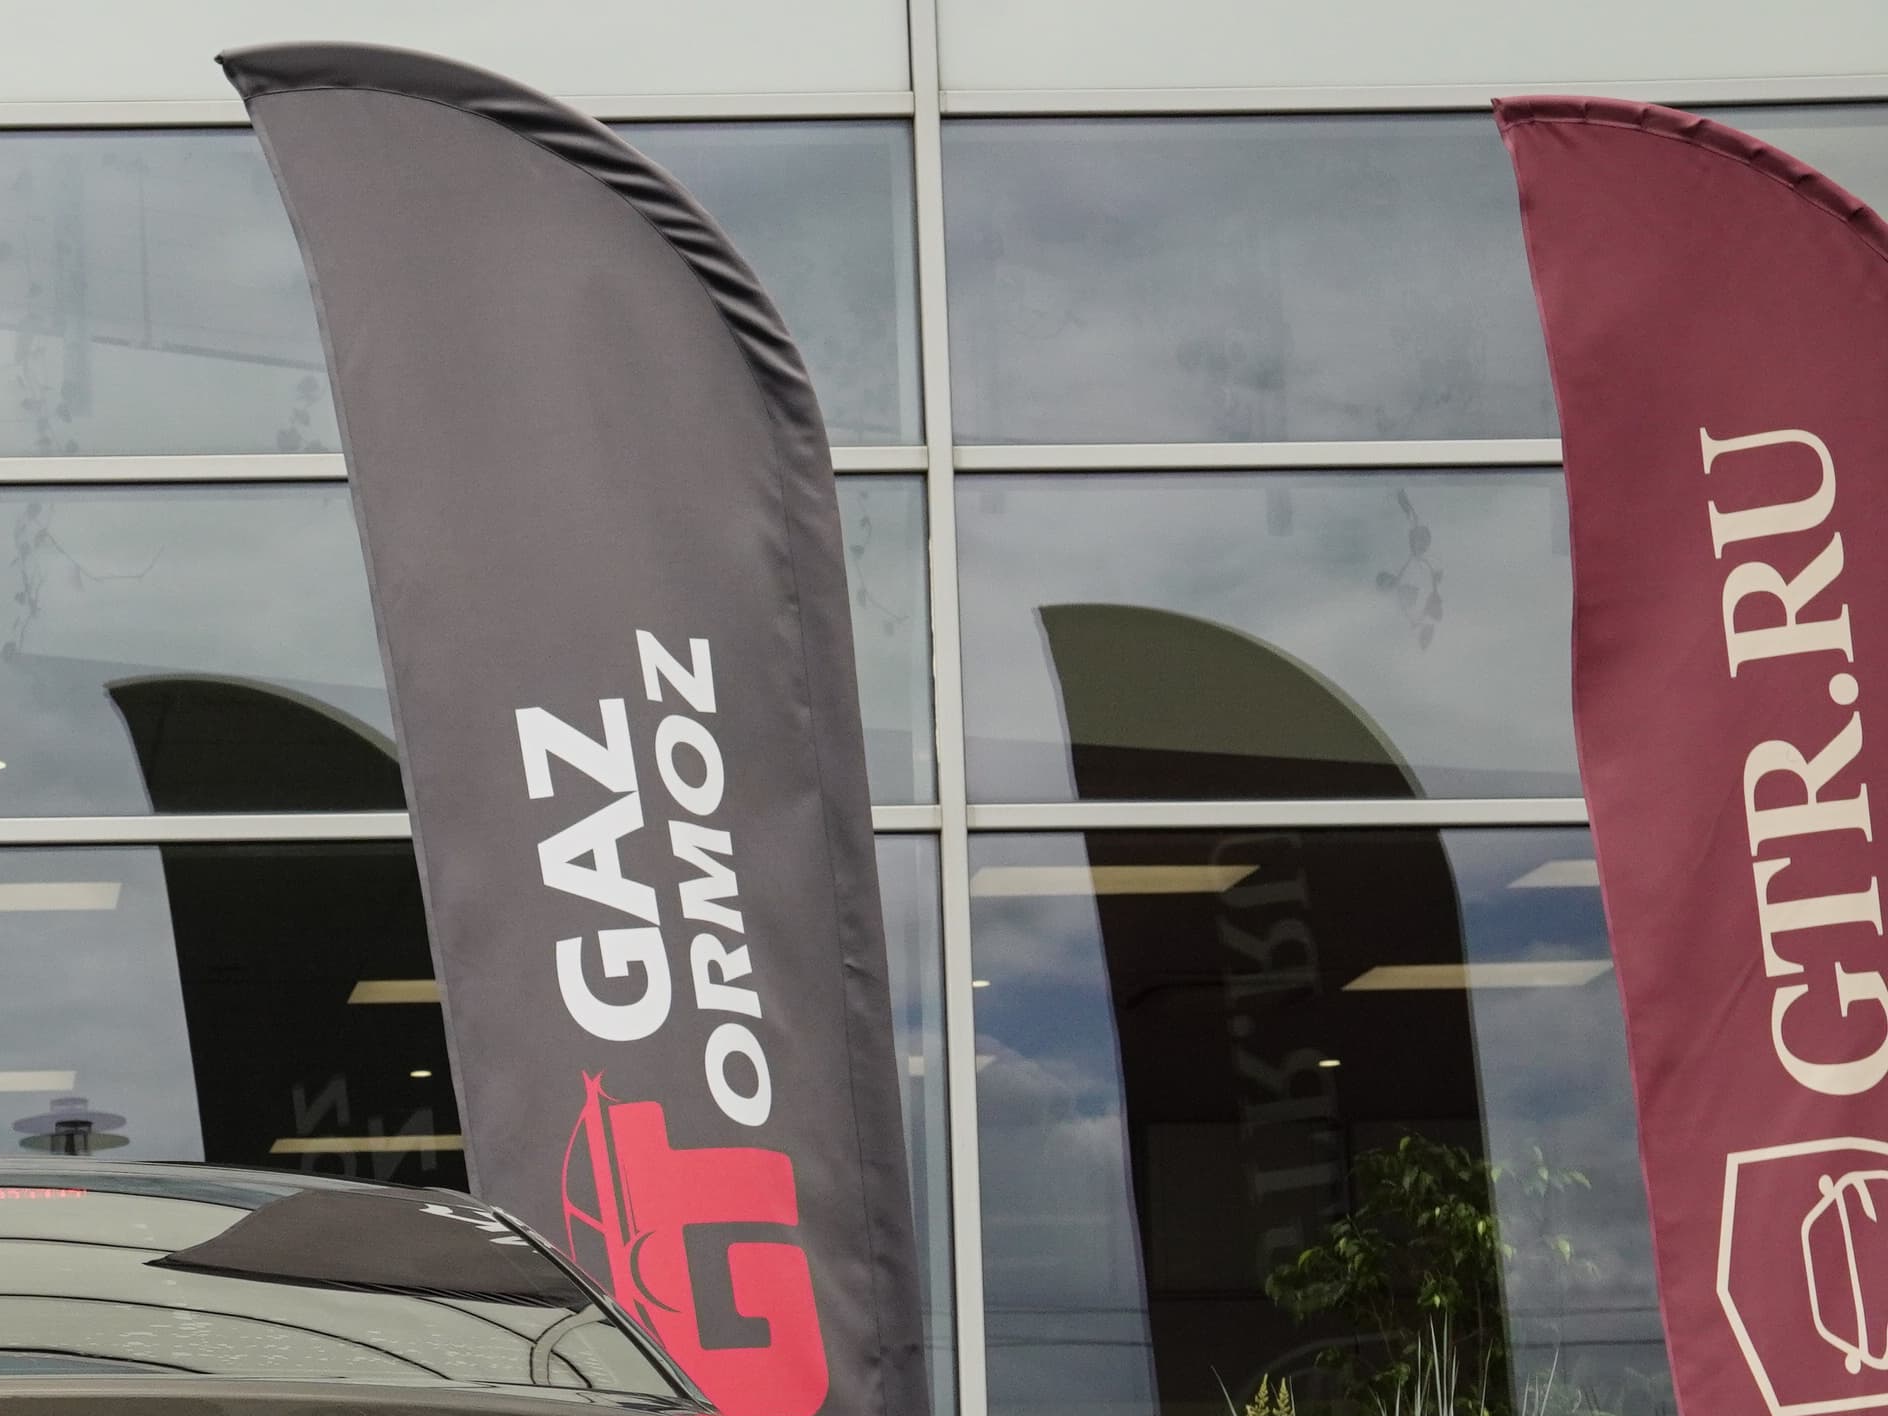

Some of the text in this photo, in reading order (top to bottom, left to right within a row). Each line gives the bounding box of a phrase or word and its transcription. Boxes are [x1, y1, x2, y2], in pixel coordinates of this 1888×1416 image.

[515, 698, 674, 1042] GAZ
[636, 629, 773, 1127] ORMOZ
[1699, 426, 1888, 1096] GTR.RU
